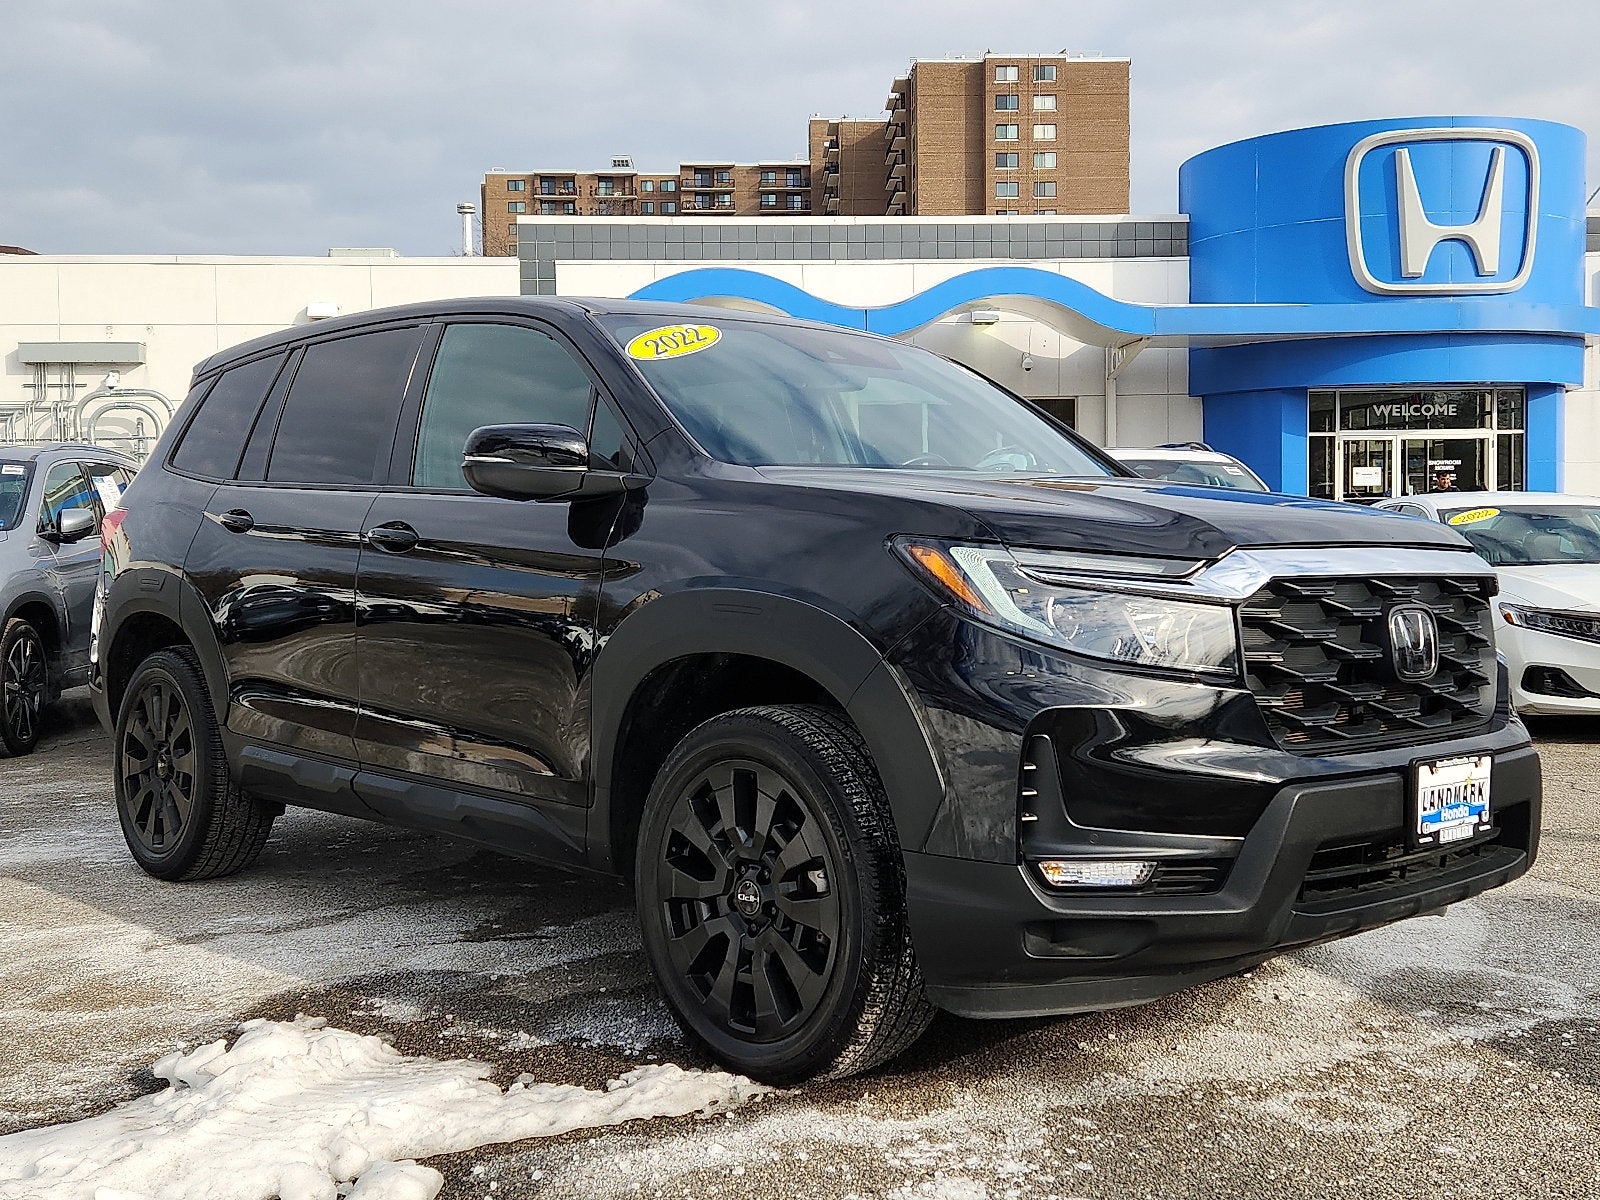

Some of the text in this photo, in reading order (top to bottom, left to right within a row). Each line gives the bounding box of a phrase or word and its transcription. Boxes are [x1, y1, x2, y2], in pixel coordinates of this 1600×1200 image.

[644, 327, 708, 356] 2022
[1372, 404, 1458, 417] WELCOME
[1458, 509, 1492, 523] 2022
[1422, 781, 1486, 812] LANDMARK
[1441, 804, 1470, 821] Honda
